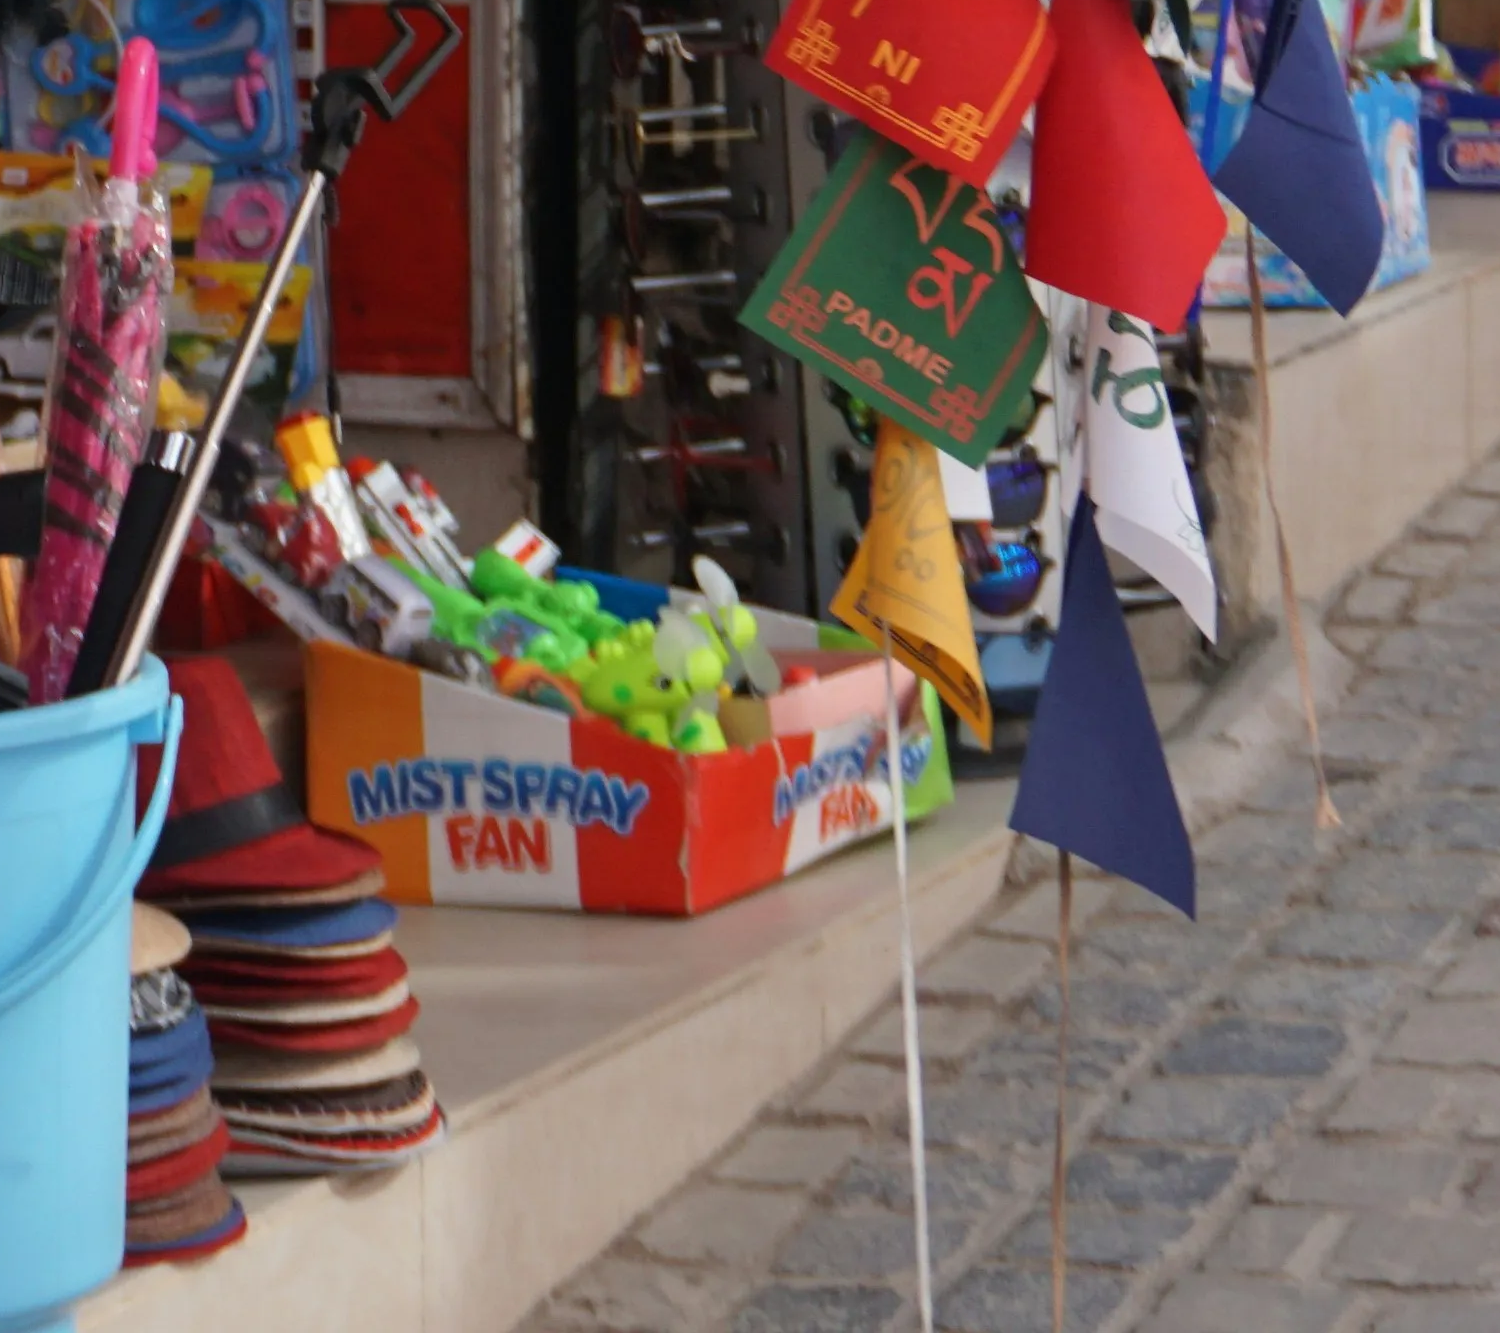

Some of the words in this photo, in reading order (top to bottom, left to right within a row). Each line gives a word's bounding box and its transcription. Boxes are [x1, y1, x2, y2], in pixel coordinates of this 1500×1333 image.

[870, 39, 922, 85] NI
[825, 290, 954, 386] PADME
[347, 758, 480, 827] MIST
[481, 758, 651, 837] SPRAY
[444, 815, 551, 874] FAN
